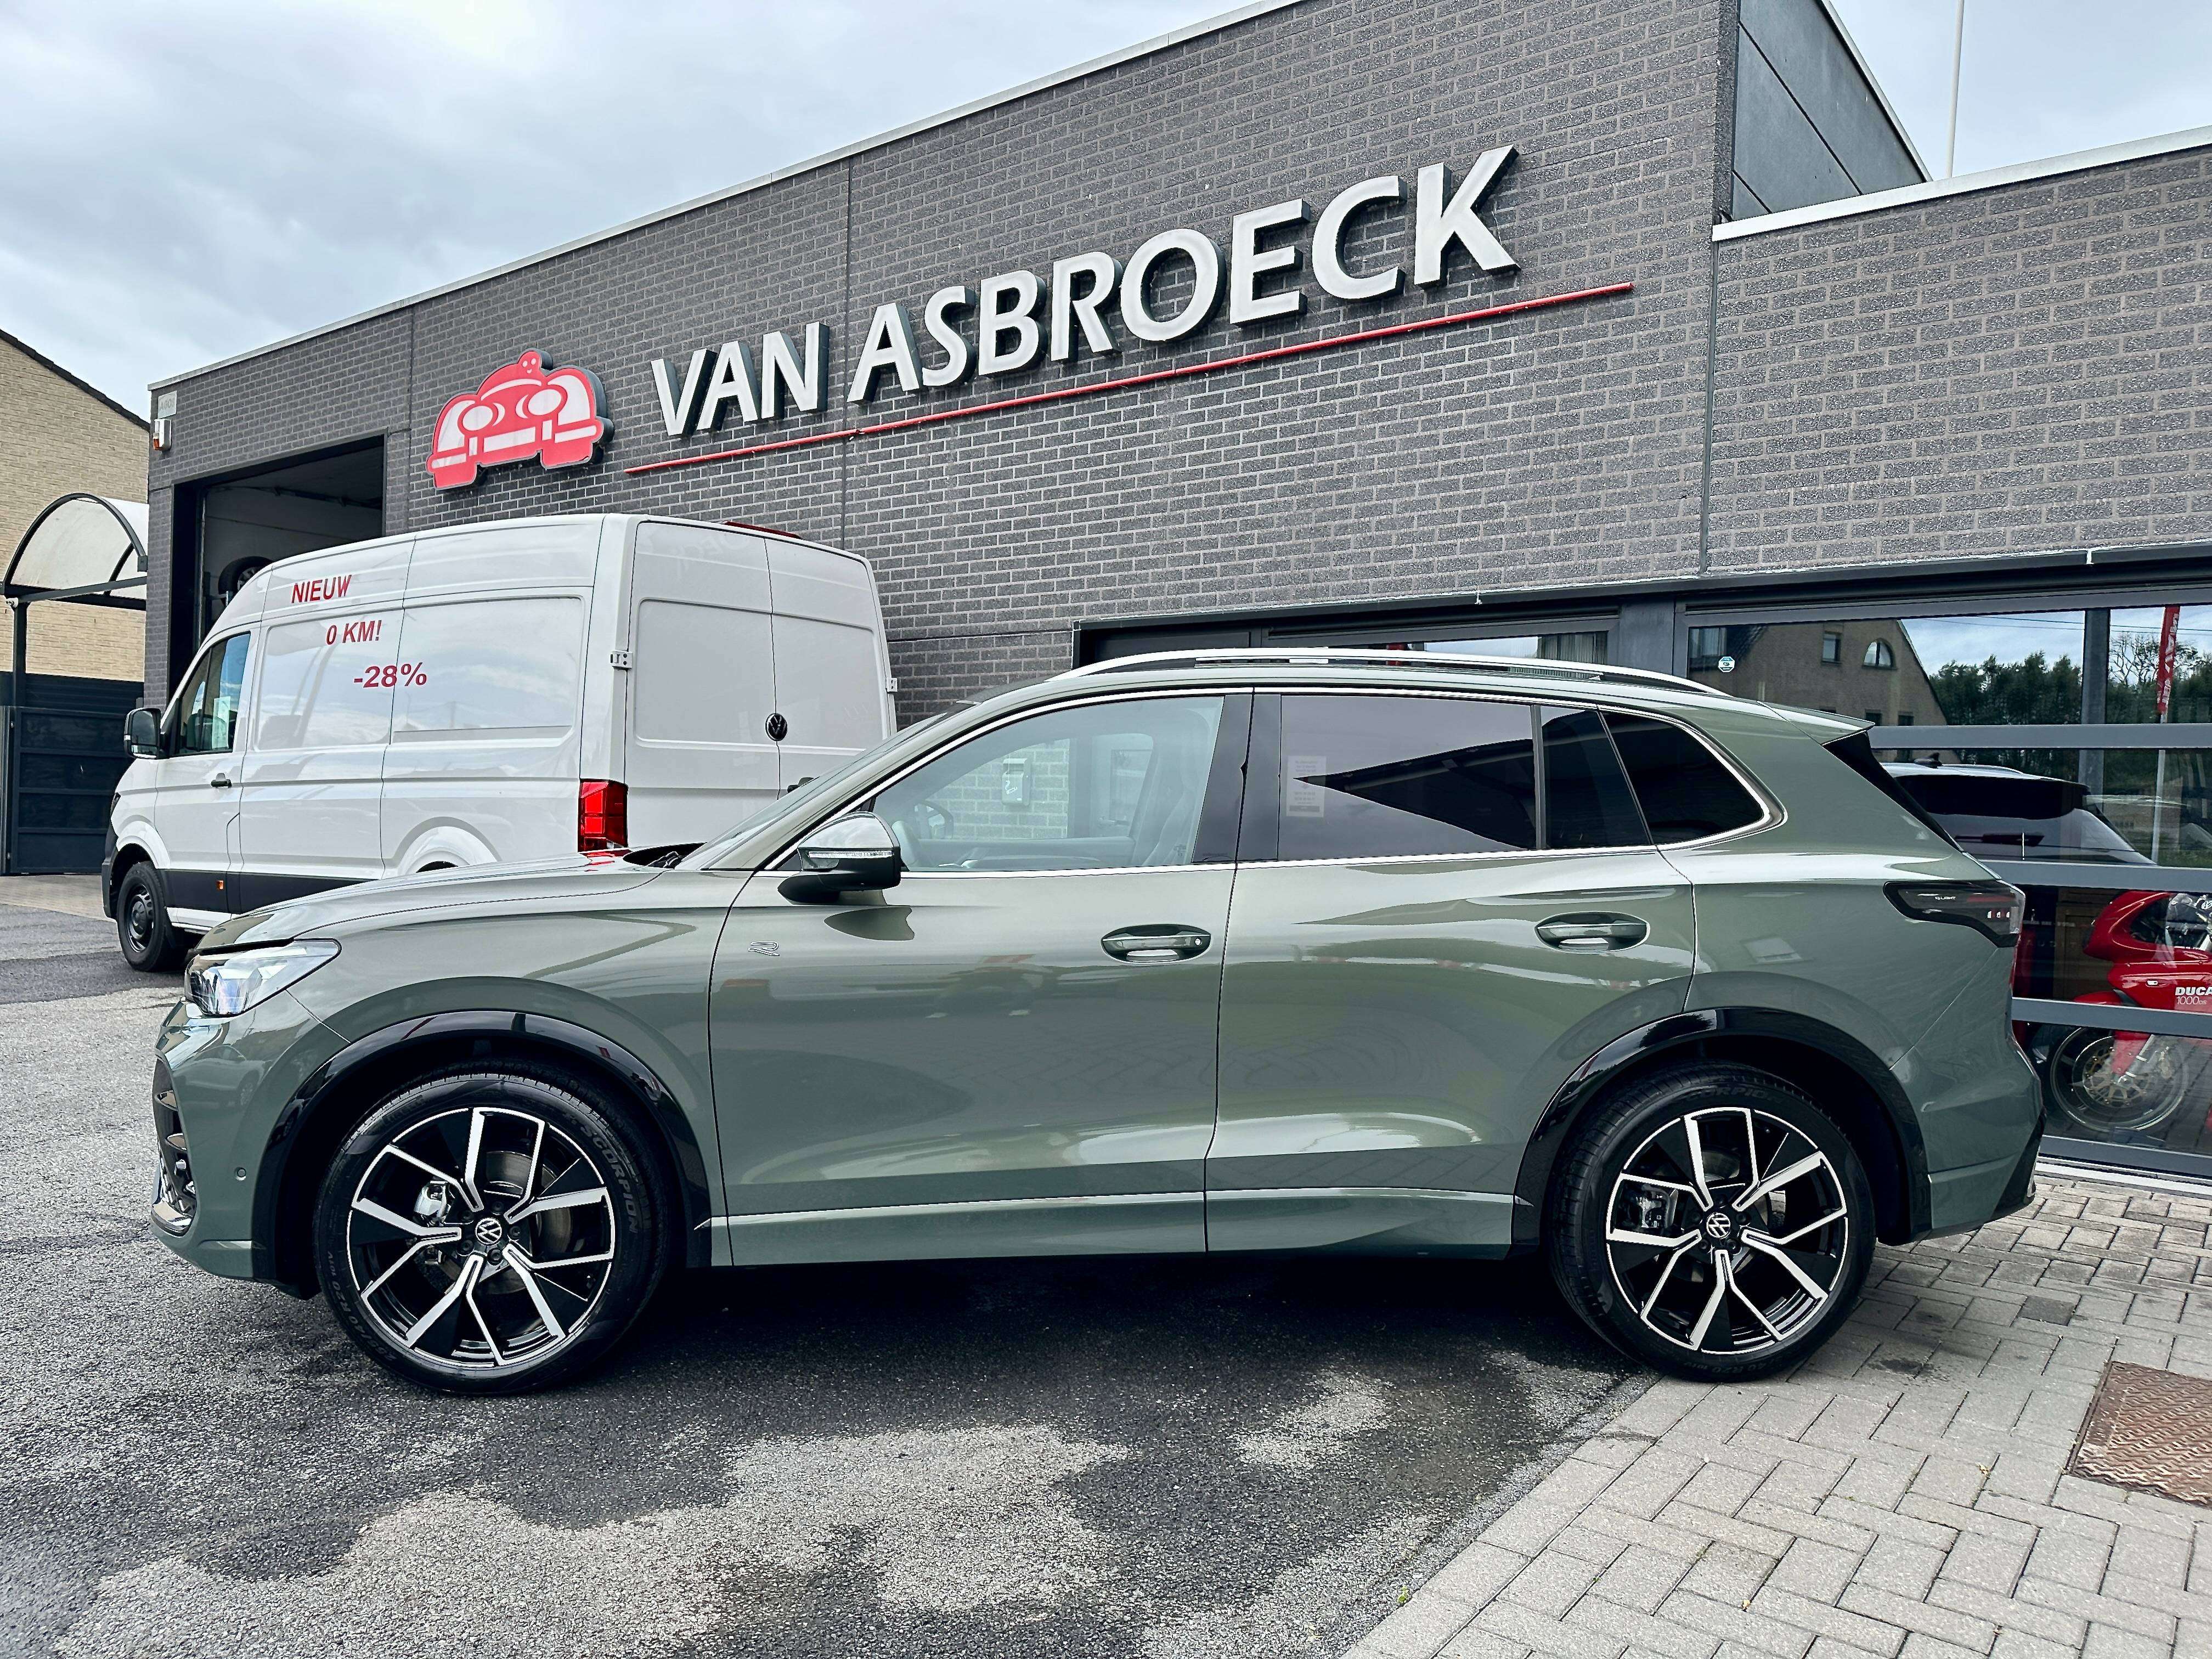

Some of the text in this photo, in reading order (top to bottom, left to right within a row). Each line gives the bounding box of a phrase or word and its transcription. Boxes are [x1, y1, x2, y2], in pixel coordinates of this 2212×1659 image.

[651, 144, 1520, 437] VAN ASBROECK
[291, 574, 352, 603] NIEUW
[326, 620, 382, 645] 0 KM!
[353, 662, 427, 689] -28%
[2175, 986, 2212, 996] DUCA
[580, 1125, 639, 1233] SCORPION
[332, 1281, 352, 1312] R20
